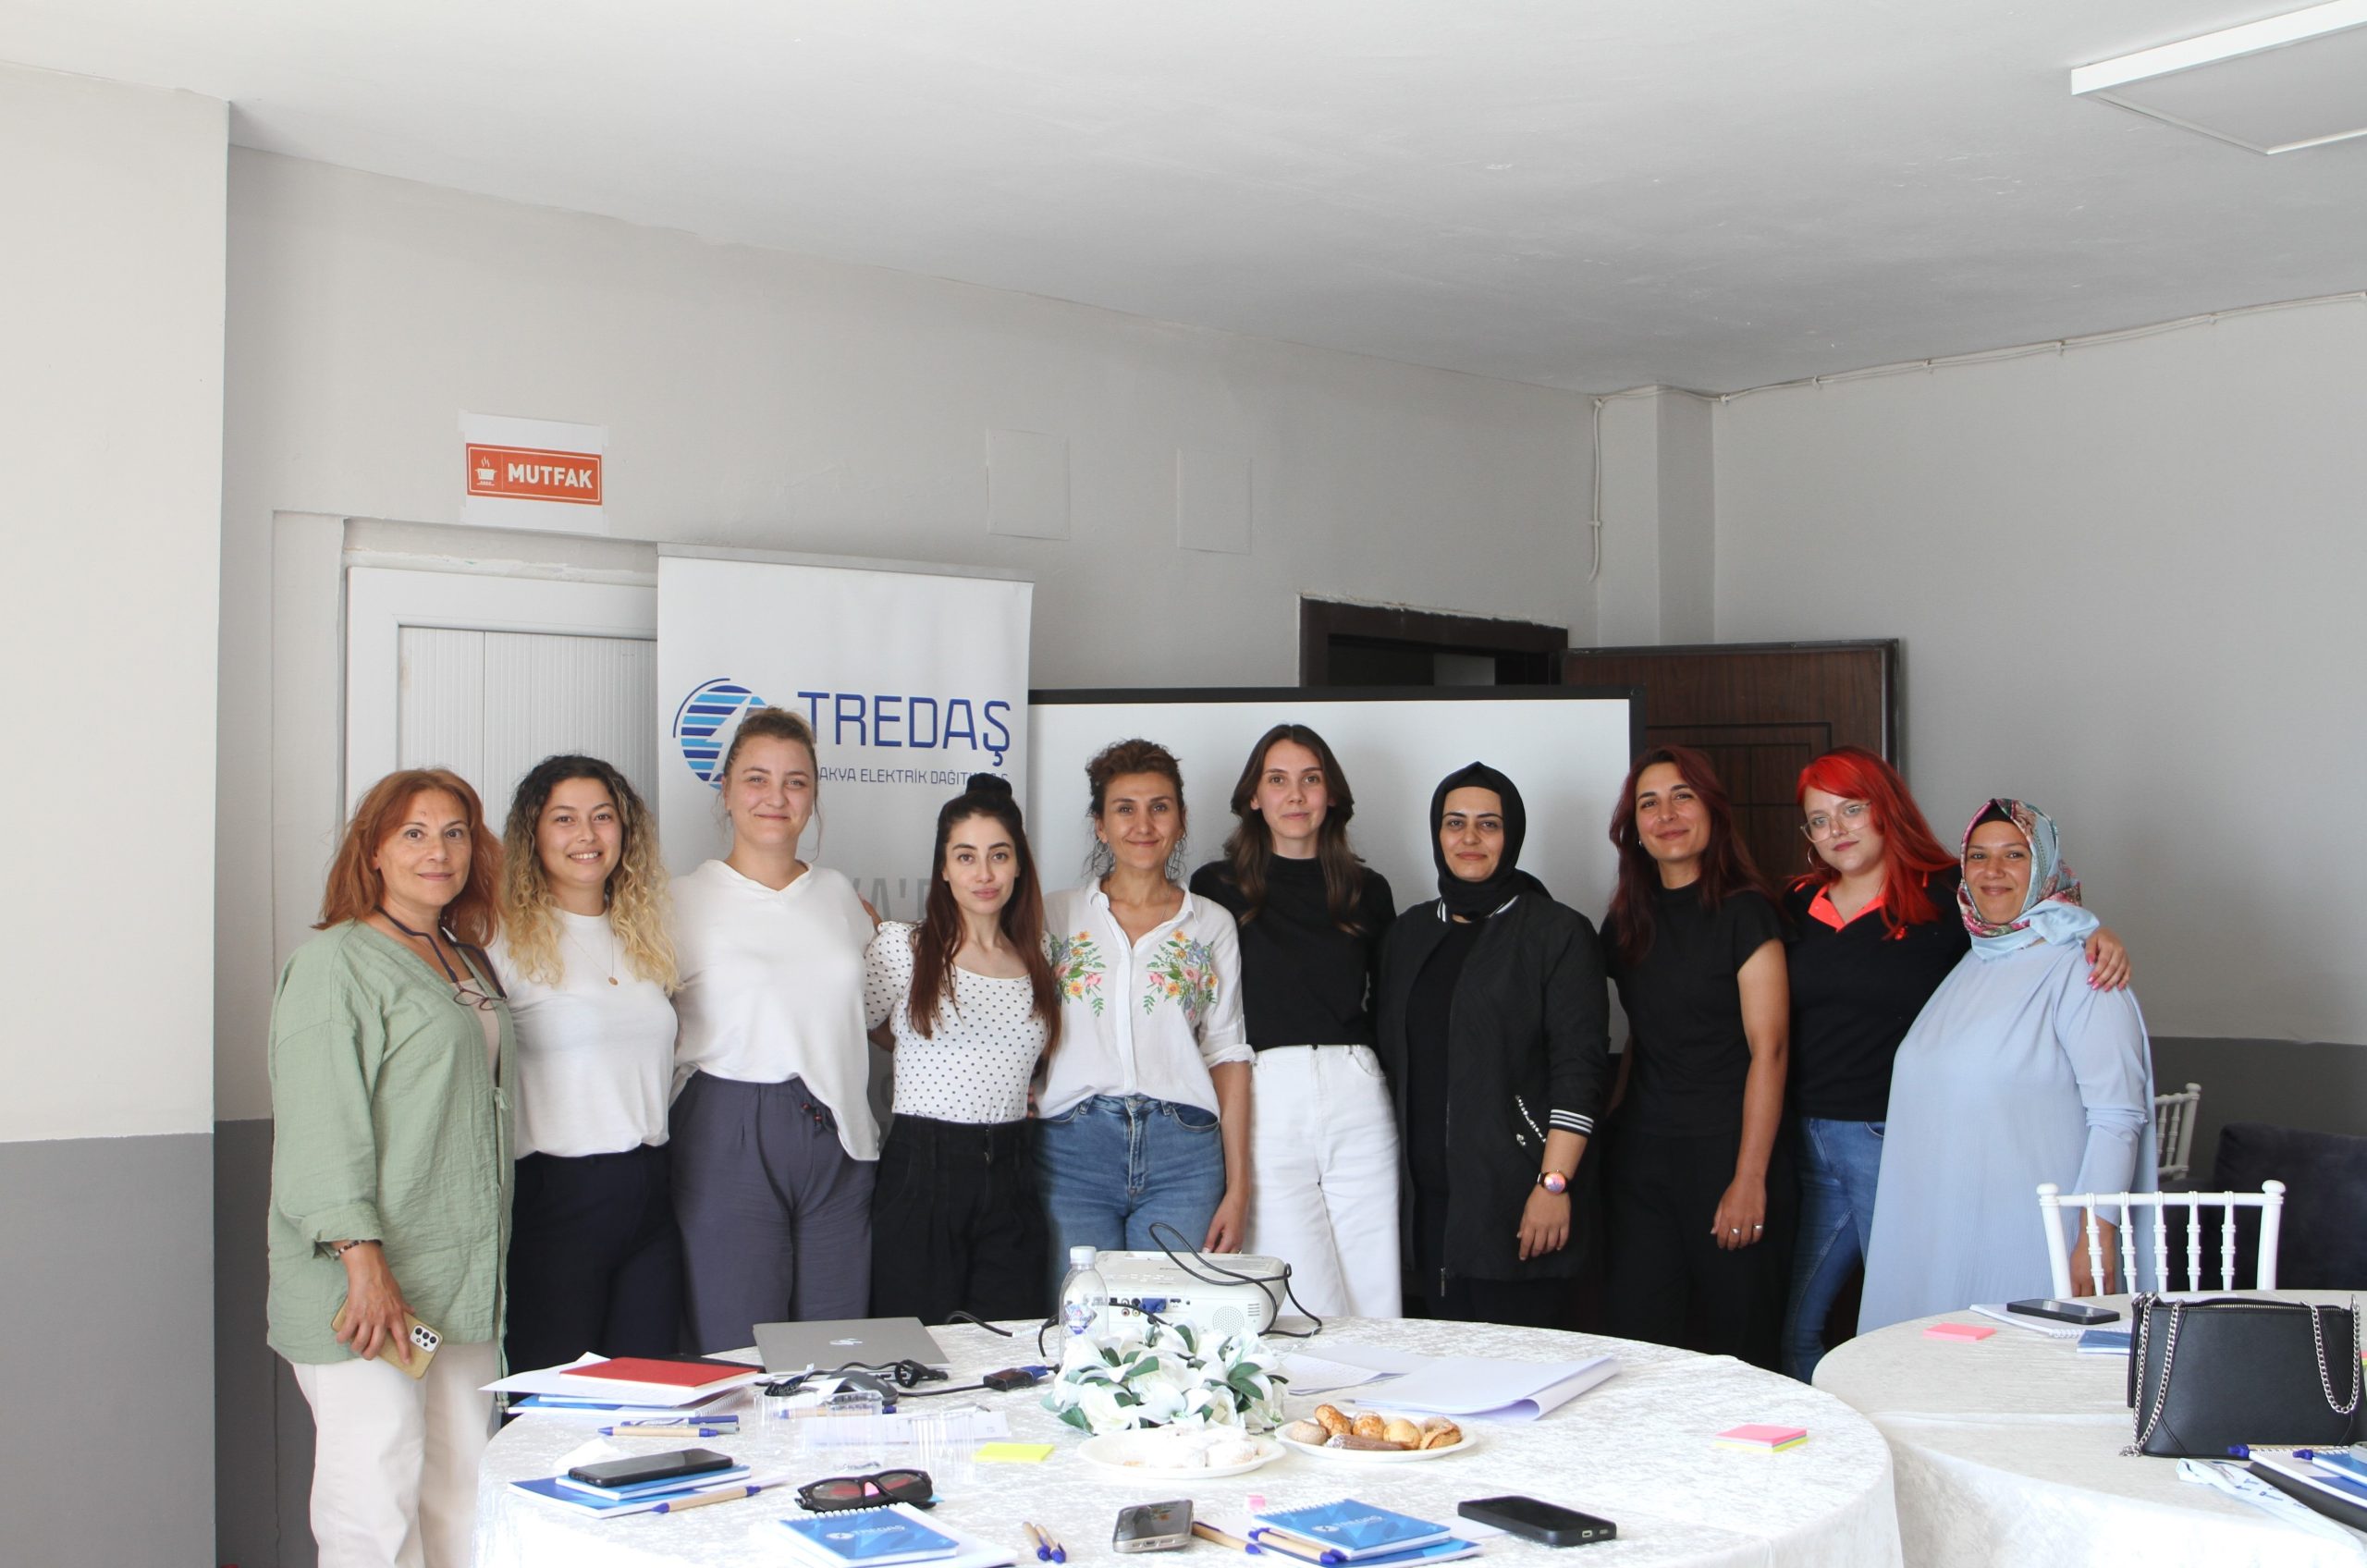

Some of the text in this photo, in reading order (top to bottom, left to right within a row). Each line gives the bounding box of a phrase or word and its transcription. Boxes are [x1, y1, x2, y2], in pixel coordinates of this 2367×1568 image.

[508, 463, 593, 488] MUTFAK
[797, 691, 1011, 766] TREDAŞ
[819, 766, 856, 782] AKYA
[860, 767, 927, 784] ELEKTRİK
[930, 769, 976, 786] DAĞIT
